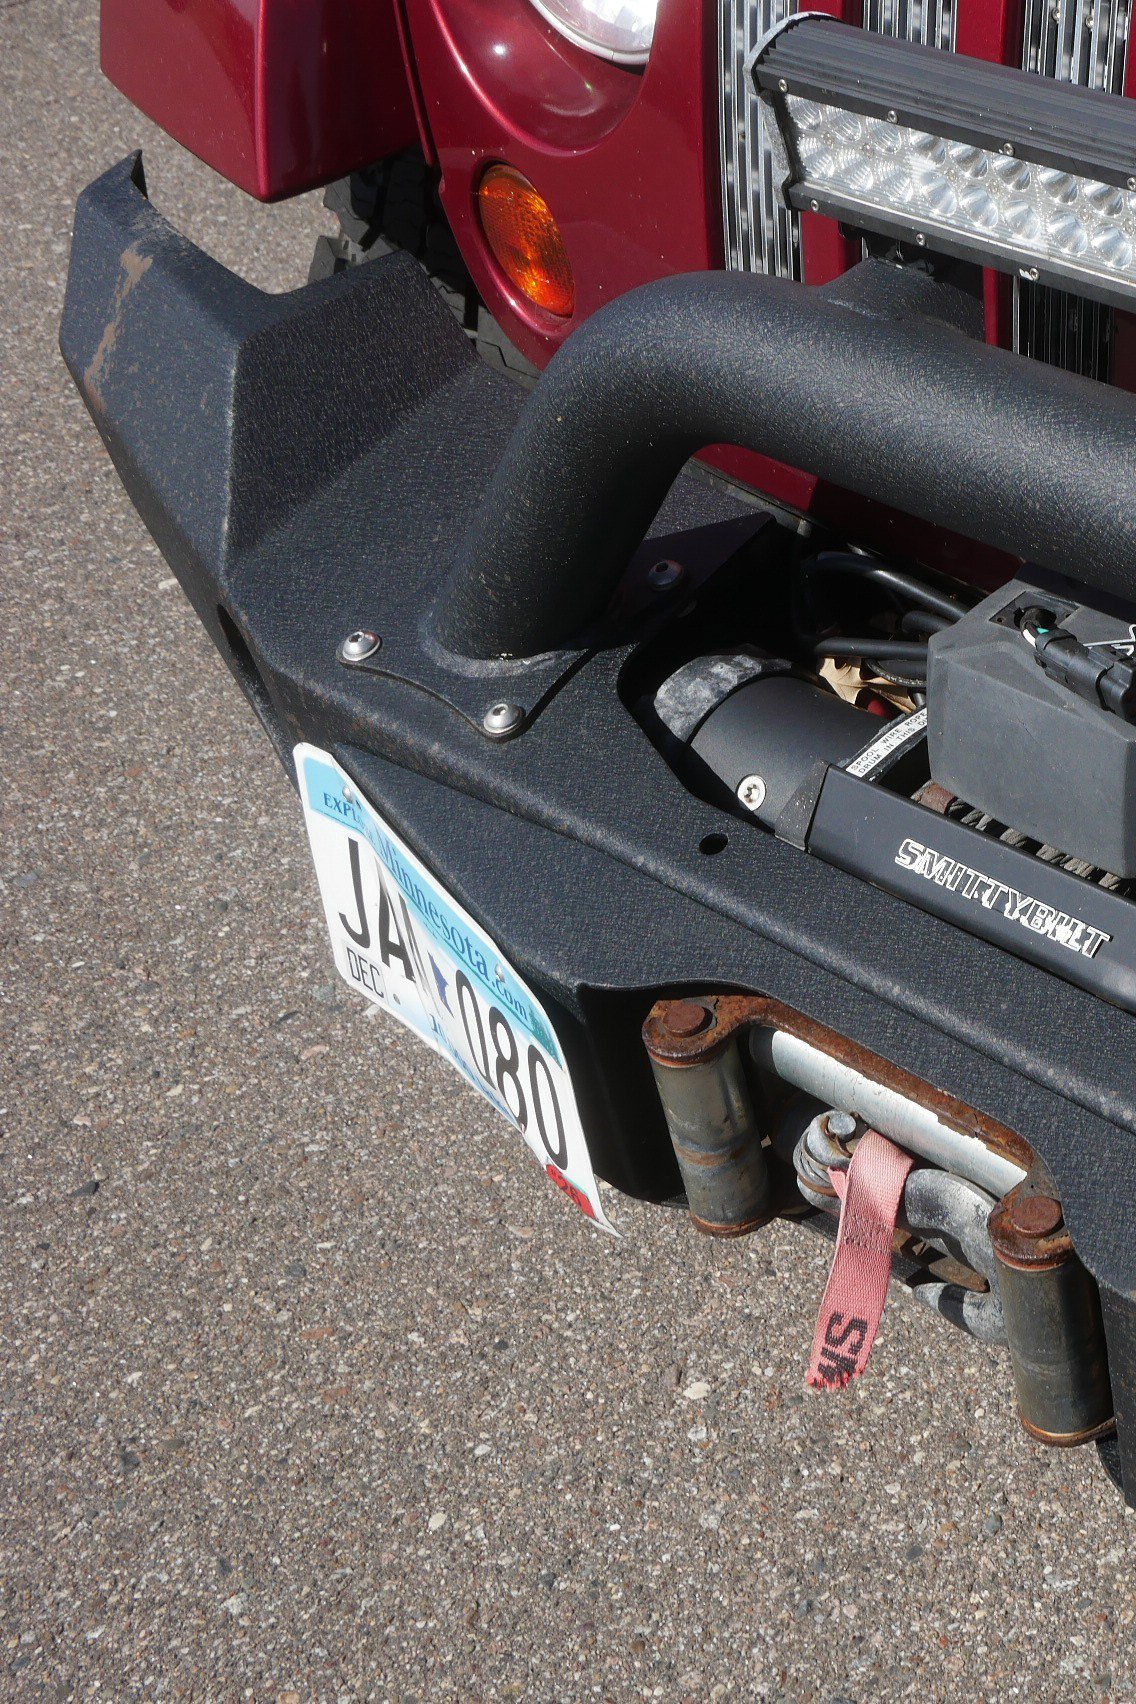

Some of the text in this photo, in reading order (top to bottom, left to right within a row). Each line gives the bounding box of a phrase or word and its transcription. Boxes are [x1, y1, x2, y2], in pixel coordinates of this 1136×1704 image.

[851, 748, 879, 770] SPOOL
[881, 727, 902, 744] WIRE
[858, 754, 882, 774] DRUM
[884, 743, 894, 752] IN
[896, 727, 916, 741] THIS
[894, 838, 1111, 959] SMITTYBILT
[347, 947, 384, 999] DEC
[456, 969, 568, 1170] 080
